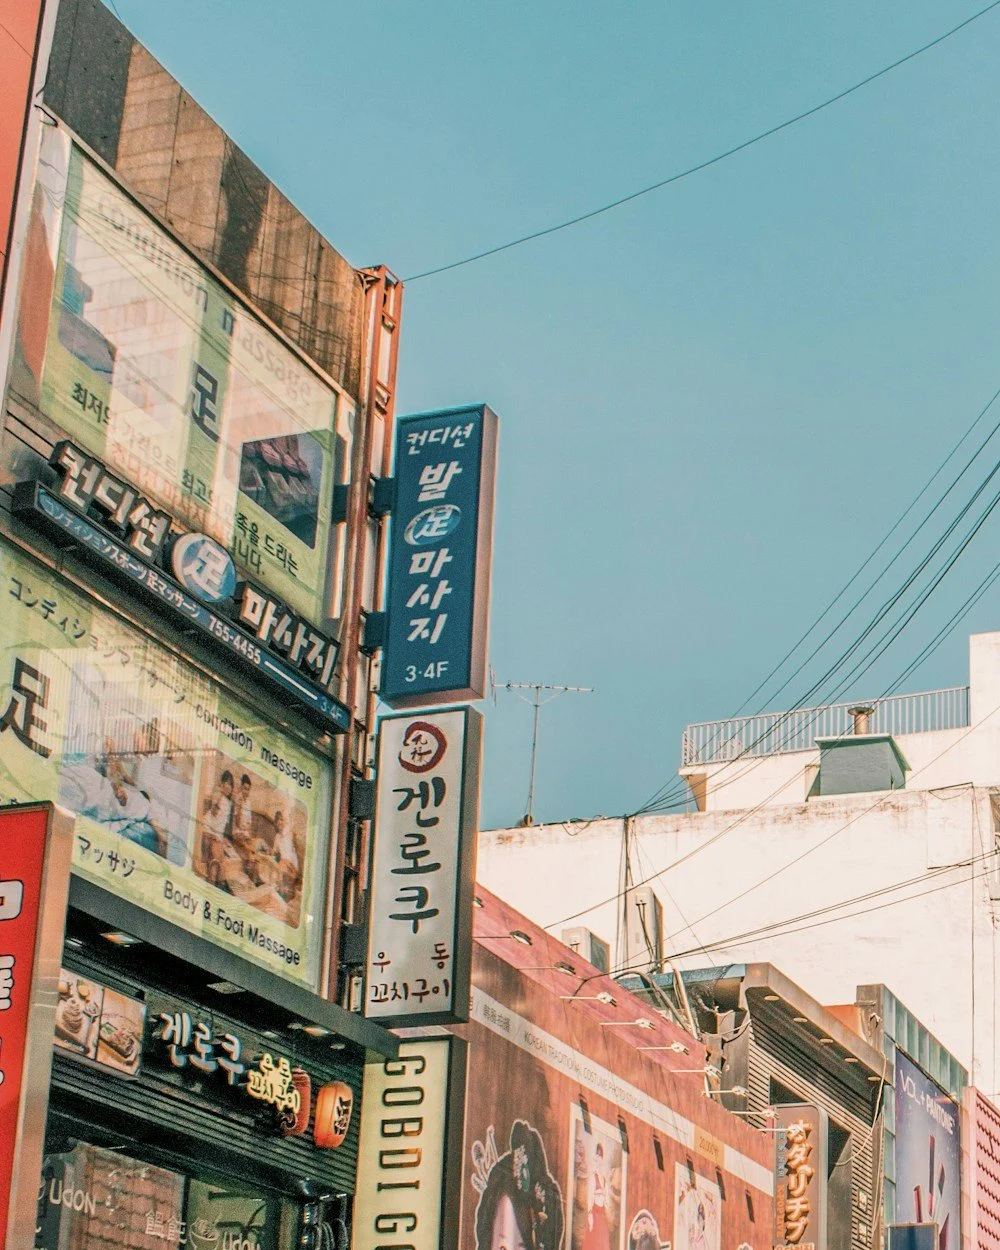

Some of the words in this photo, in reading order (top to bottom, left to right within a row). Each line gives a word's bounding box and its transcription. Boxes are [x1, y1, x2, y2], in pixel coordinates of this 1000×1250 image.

[406, 422, 475, 455] 컨디션
[417, 460, 462, 502] 발
[58, 446, 172, 557] 컨디션
[182, 539, 230, 599] 足
[240, 586, 339, 686] 마사지
[405, 548, 453, 644] 마사지
[208, 616, 262, 664] 755-4455
[0, 656, 53, 759] 足
[195, 705, 254, 753] condition
[259, 745, 314, 790] massage
[388, 776, 447, 935] 겐로쿠
[163, 879, 201, 915] Body
[202, 901, 213, 920] &
[215, 910, 246, 936] Foot
[248, 926, 302, 967] Massage
[370, 978, 450, 1003] 꼬치구이
[158, 1010, 247, 1086] 겐로쿠
[376, 1054, 427, 1192] GOBDI
